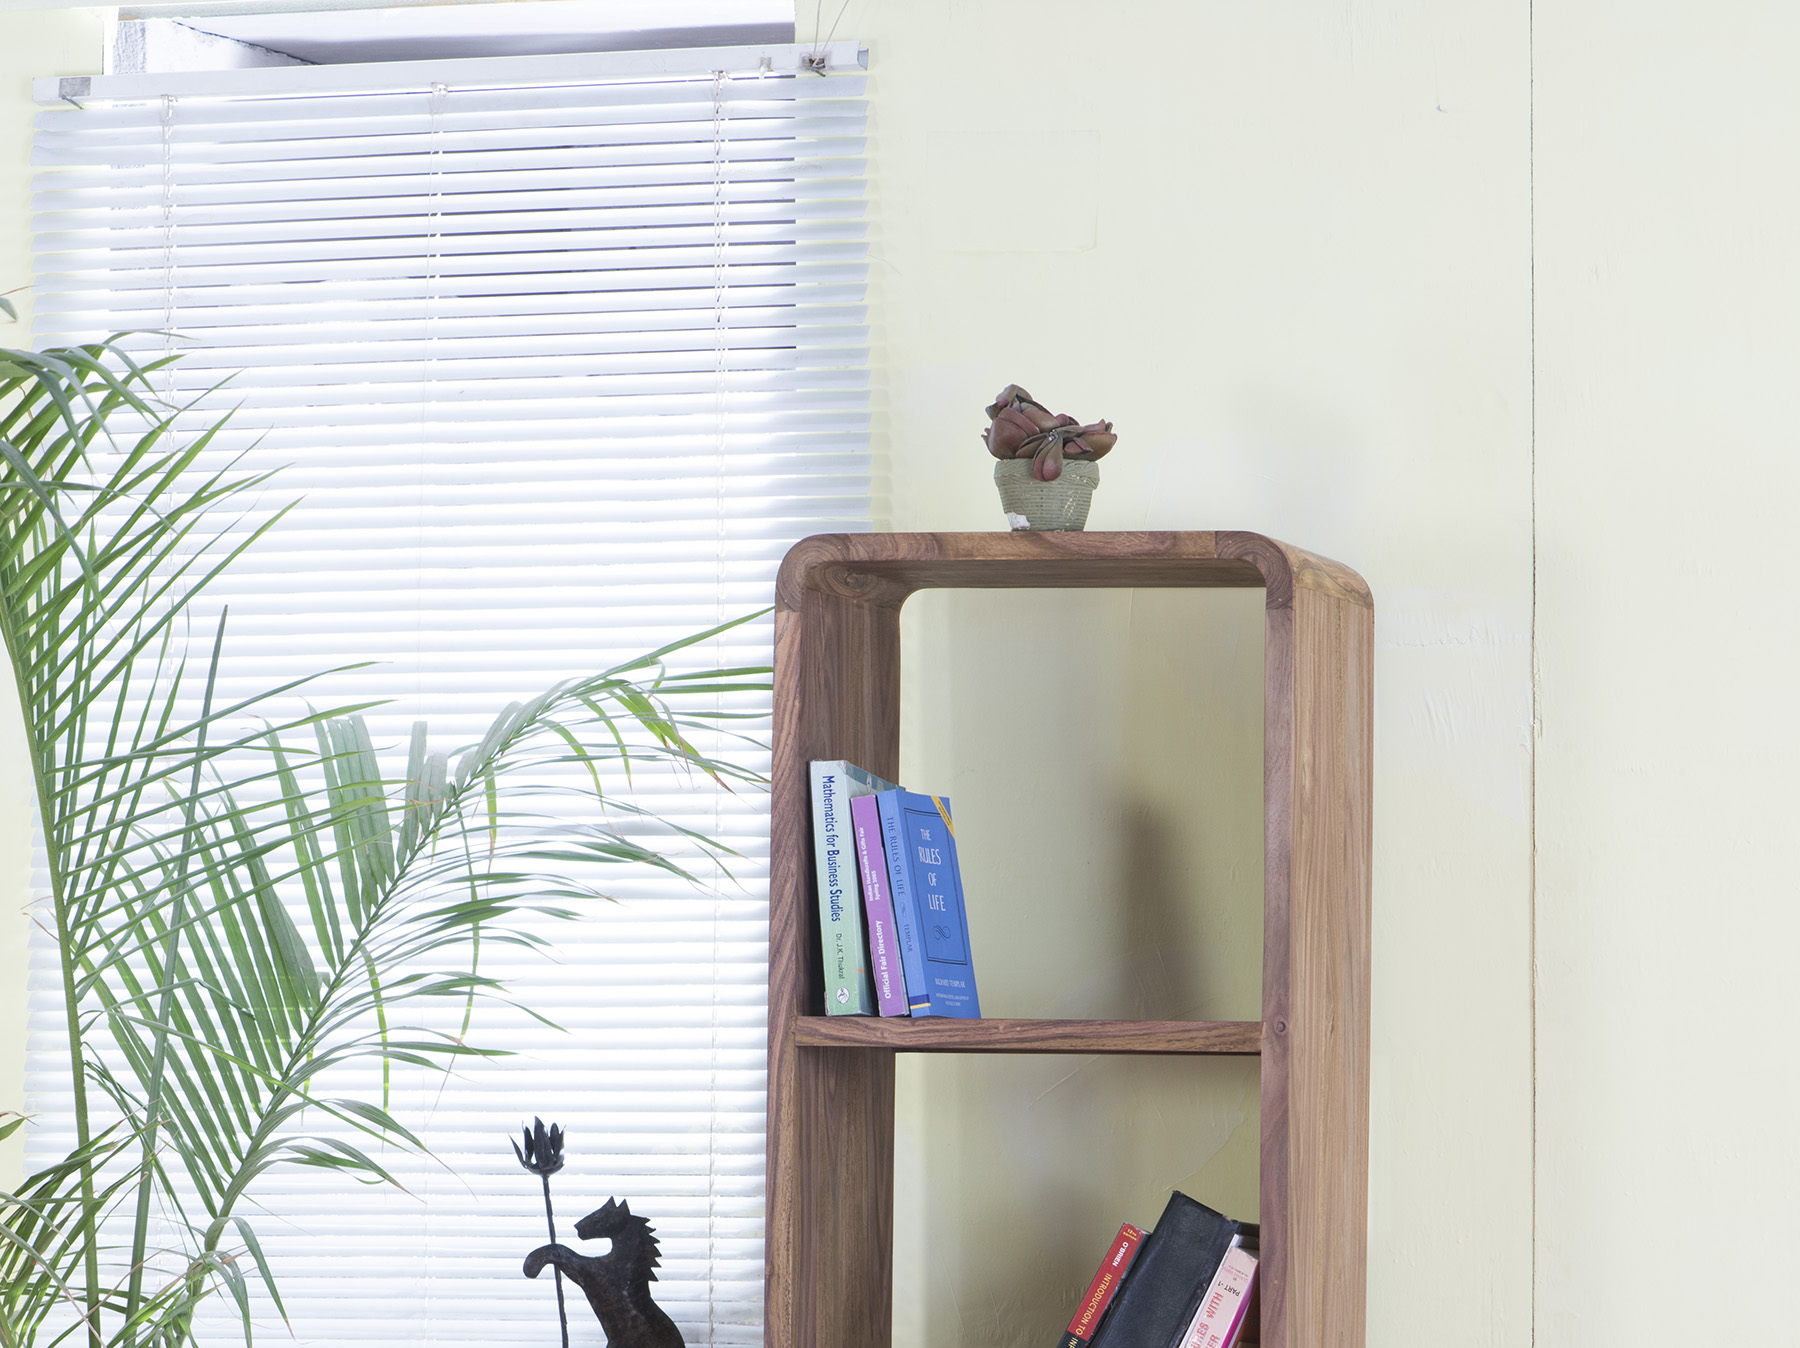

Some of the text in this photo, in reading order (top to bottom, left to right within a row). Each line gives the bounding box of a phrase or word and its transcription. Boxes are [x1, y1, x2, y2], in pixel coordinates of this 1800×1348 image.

[920, 828, 932, 841] THE
[822, 775, 844, 922] Mathematics for Business Studies
[887, 817, 905, 897] THE RULES OF LIFE
[918, 846, 942, 866] RULES
[862, 856, 872, 885] Handicrafts
[927, 872, 937, 887] OF
[873, 883, 881, 901] Spring
[927, 893, 947, 912] LIFE
[903, 923, 913, 953] TEMPLAR
[875, 920, 892, 999] Official Fair Directory
[1112, 1241, 1129, 1267] O'BRIEN
[1075, 1272, 1113, 1336] INTRODUCTION TO
[1223, 1284, 1240, 1297] PART
[1206, 1291, 1224, 1319] WITH
